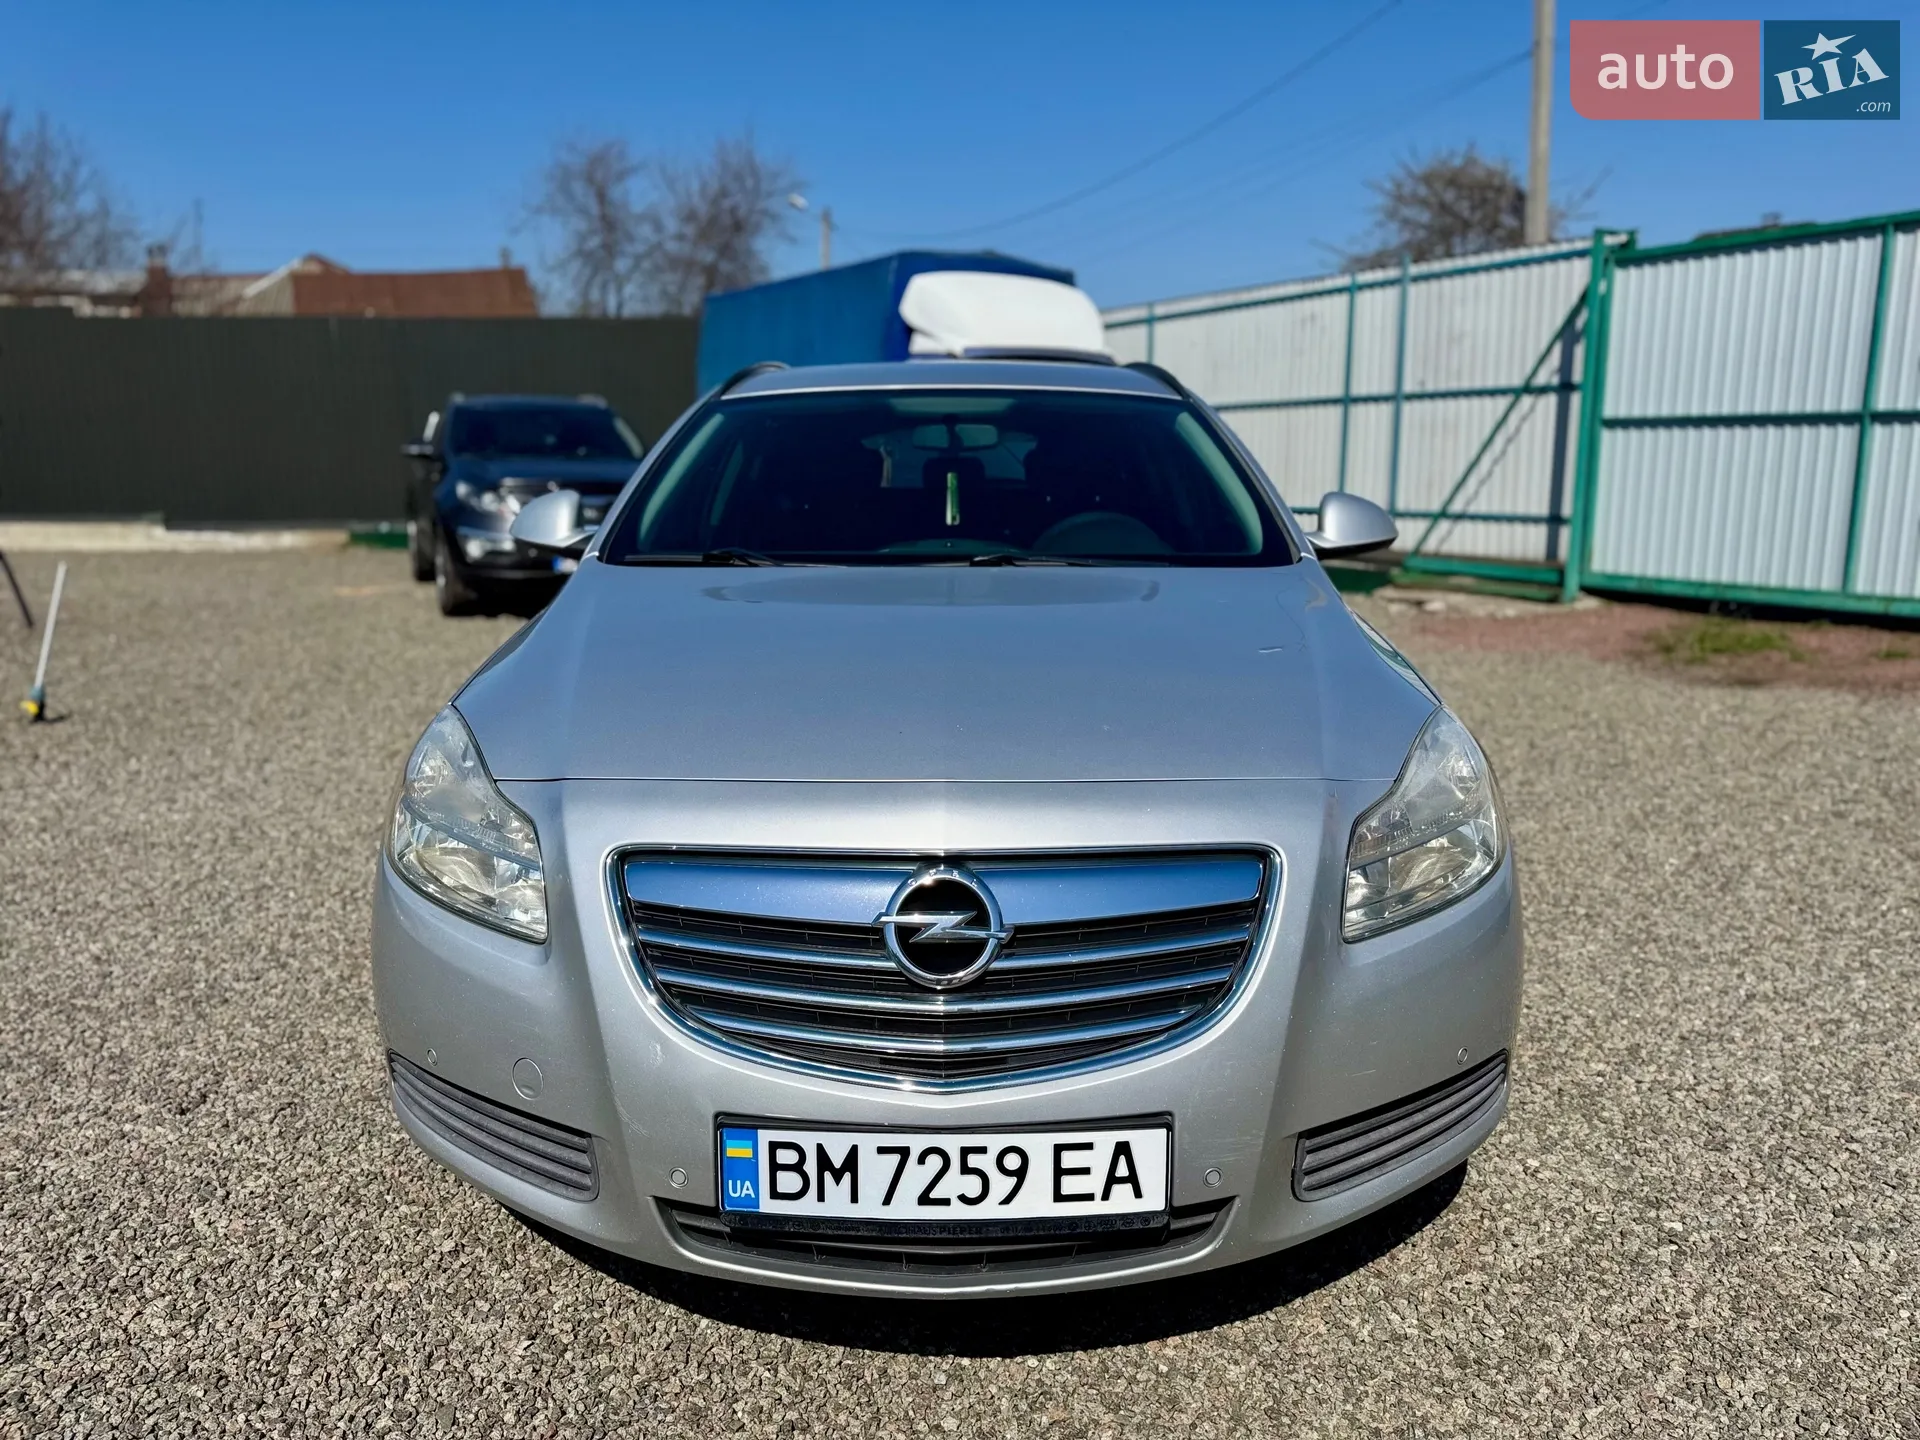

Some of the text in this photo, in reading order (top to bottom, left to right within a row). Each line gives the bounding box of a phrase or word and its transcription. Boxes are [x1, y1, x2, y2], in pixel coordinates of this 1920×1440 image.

[729, 1180, 755, 1198] UA
[769, 1141, 1142, 1206] BM 7259 EA
